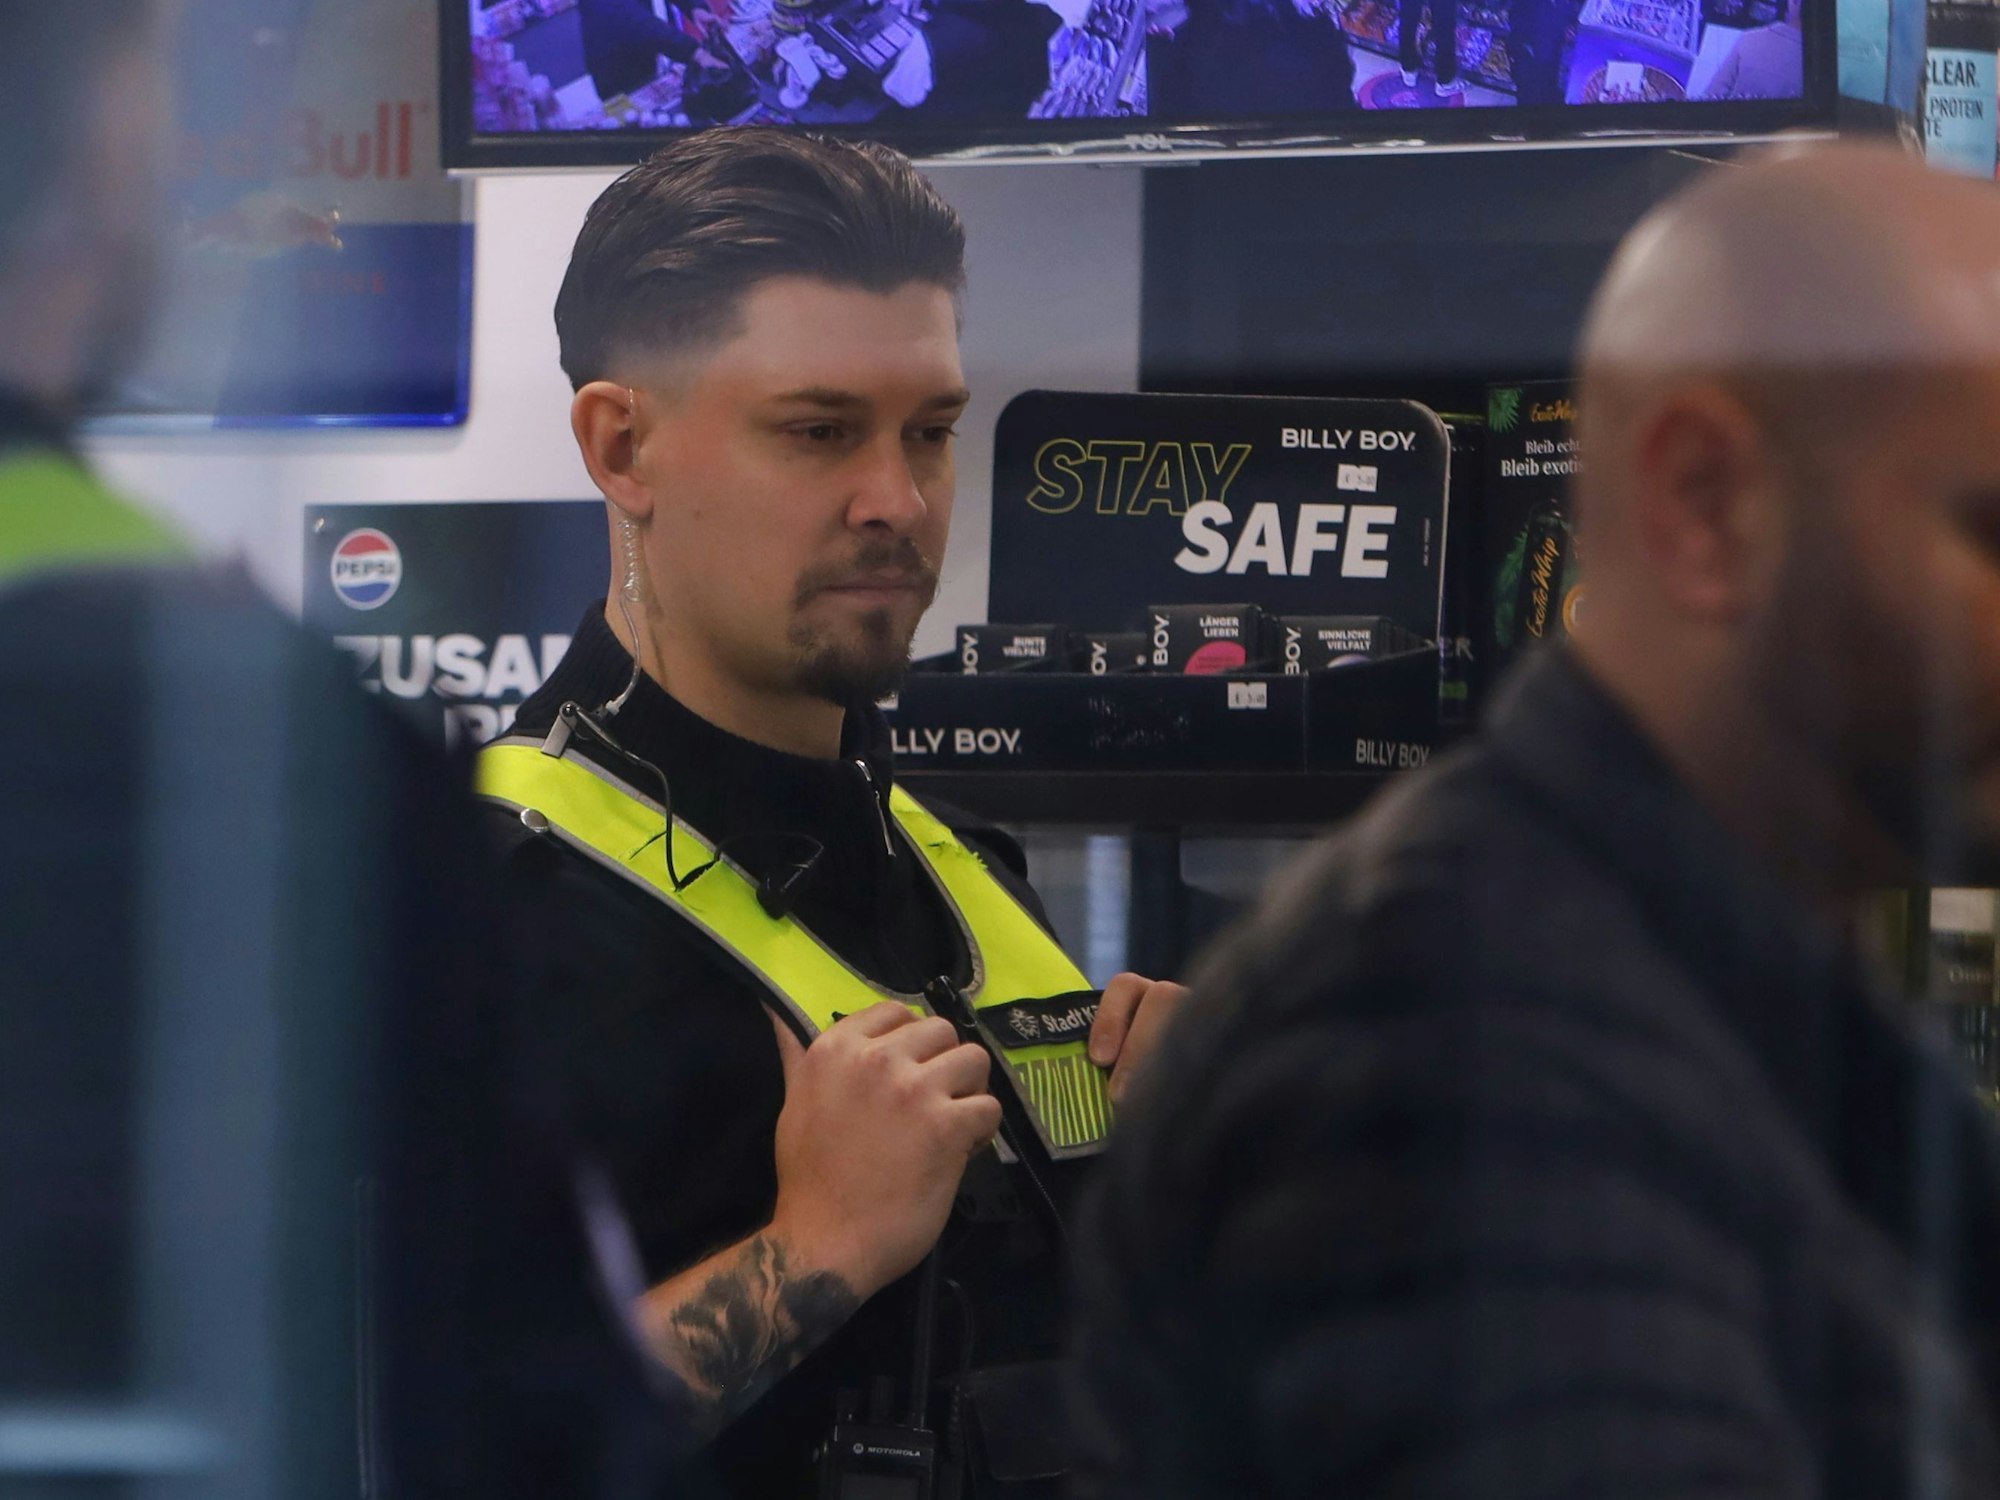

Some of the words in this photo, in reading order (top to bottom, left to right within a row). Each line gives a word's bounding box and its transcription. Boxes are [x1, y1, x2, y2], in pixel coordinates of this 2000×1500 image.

[1930, 97, 1984, 120] PROTEIN
[1924, 116, 1942, 138] TE
[1281, 427, 1353, 449] BILLY
[1525, 439, 1555, 454] Bleib
[1027, 438, 1252, 515] STAY
[1501, 457, 1540, 477] Bleib
[1173, 500, 1398, 579] SAFE
[336, 558, 395, 578] PEPSI
[1199, 616, 1240, 628] LÄNGER
[1203, 627, 1239, 638] LIEBEN
[1318, 630, 1372, 641] SINNLICHE
[1327, 640, 1371, 651] VIELFALT
[1003, 646, 1046, 657] VIELFALT
[1091, 641, 1107, 676] OY
[891, 728, 945, 754] LLY
[1356, 738, 1396, 766] BILLY
[1041, 1008, 1087, 1033] Stadt
[868, 1446, 921, 1457] MOTOROLA
